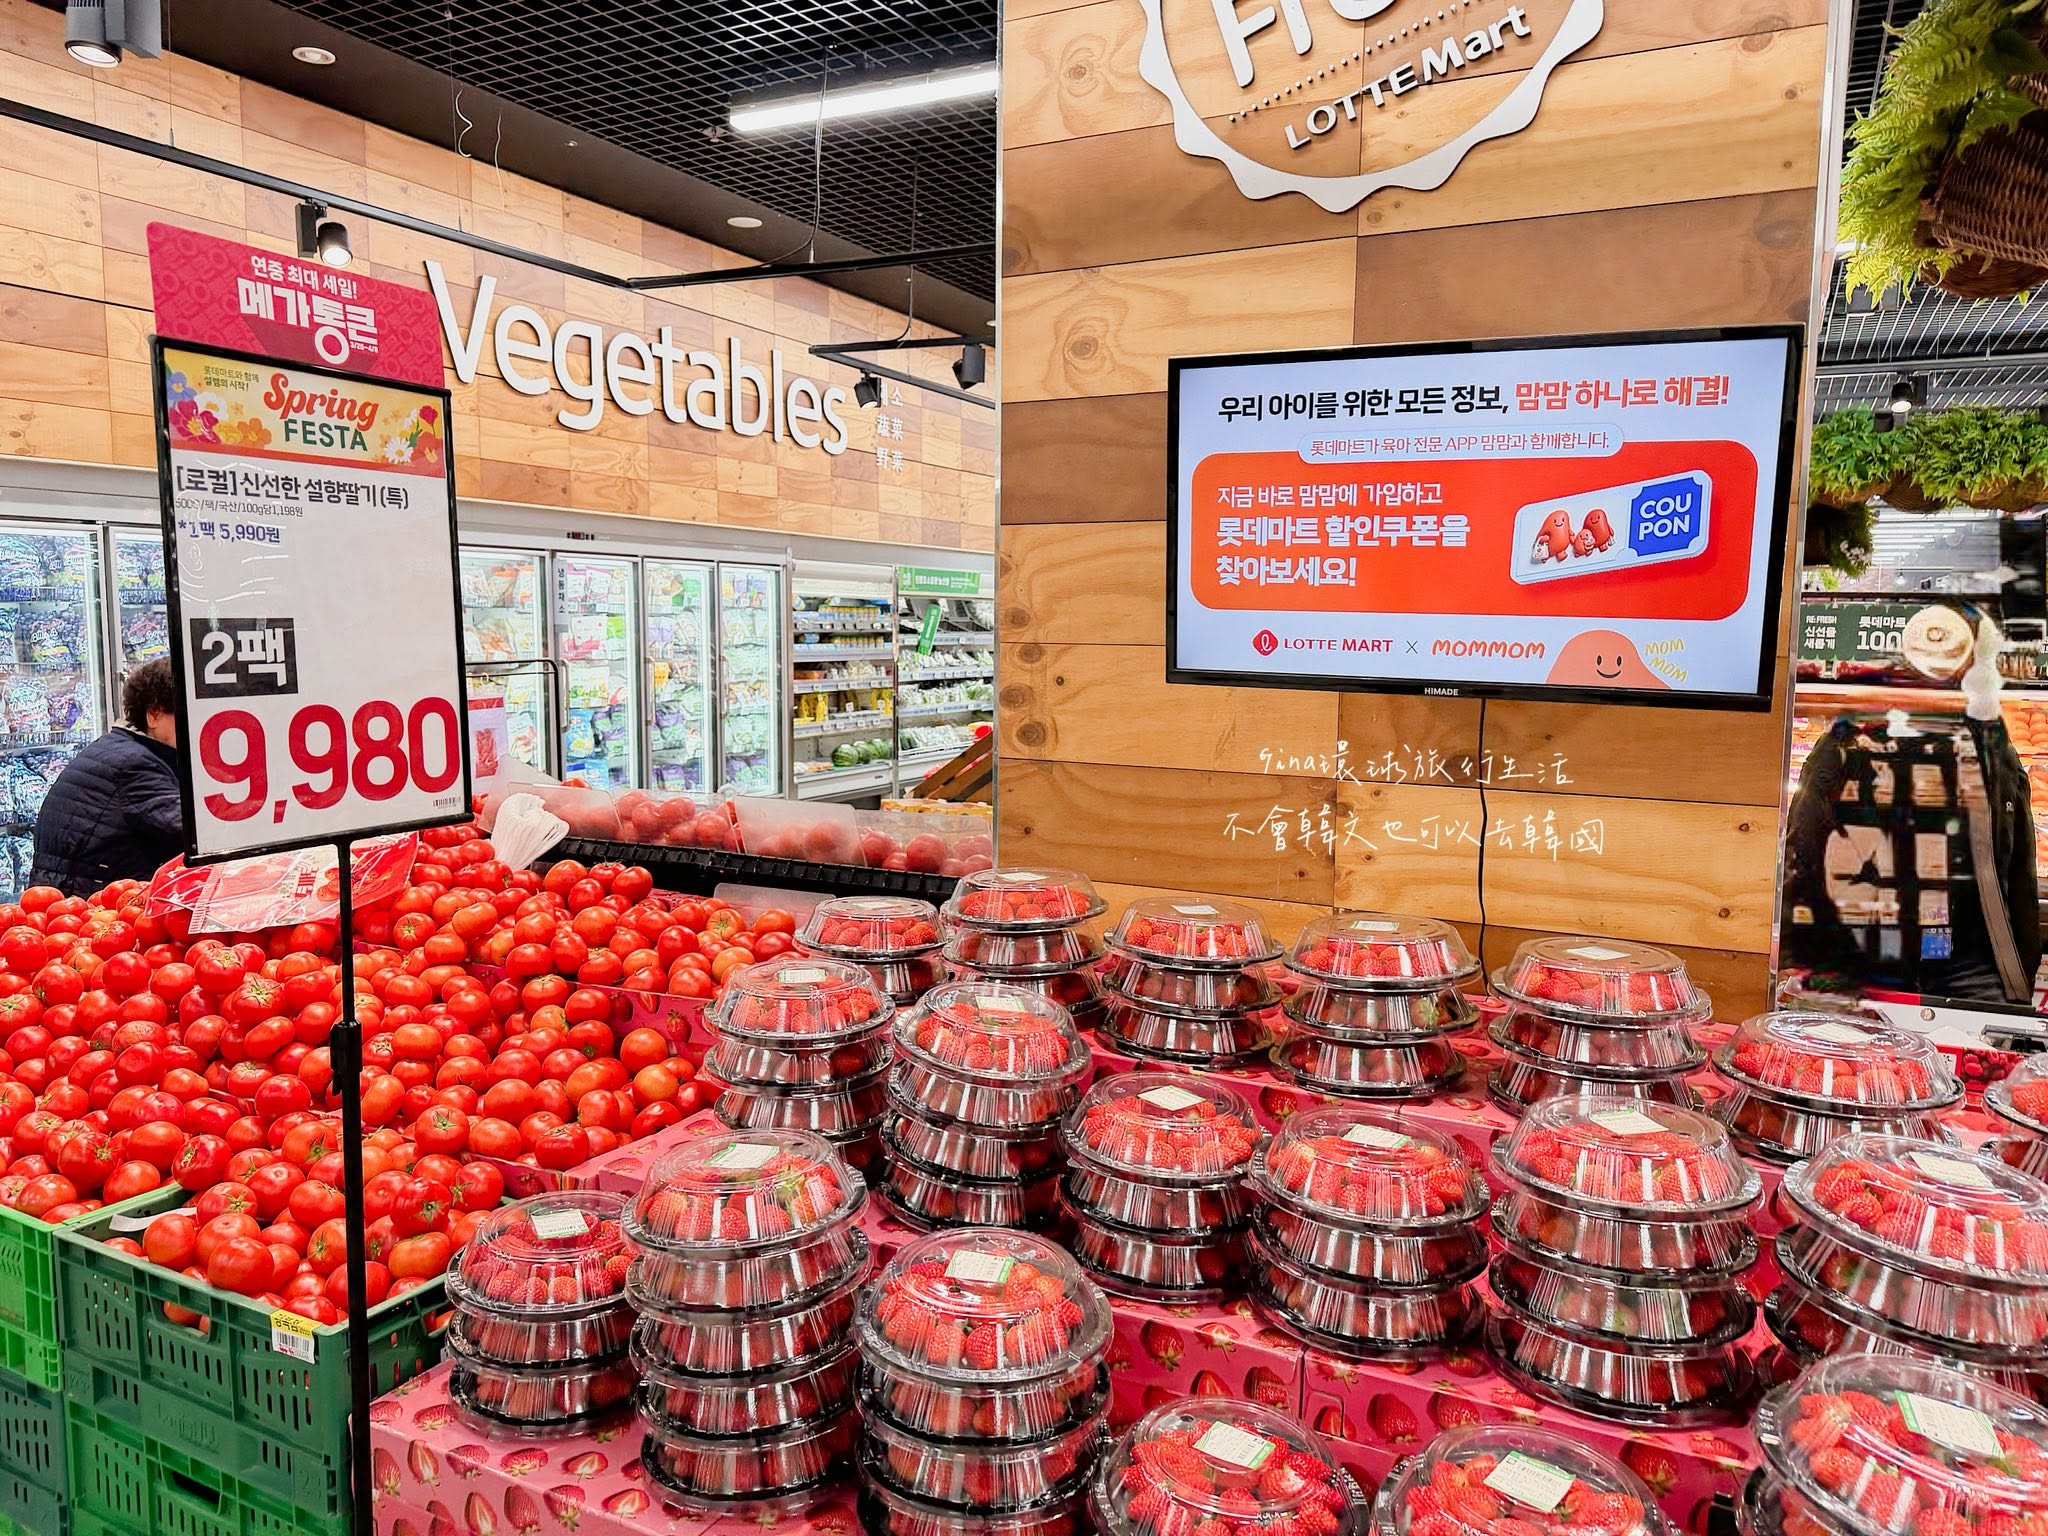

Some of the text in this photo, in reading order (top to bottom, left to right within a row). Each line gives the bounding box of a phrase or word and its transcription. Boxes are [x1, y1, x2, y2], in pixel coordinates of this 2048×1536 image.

[1284, 60, 1419, 150] LOTTE
[1421, 5, 1532, 84] Mart
[250, 255, 358, 300] 연중 최대 세일!
[237, 277, 379, 365] 메가통큰
[423, 260, 849, 455] Vegetables
[204, 366, 243, 380] 롯데마트와
[230, 380, 250, 392] 시작!
[263, 372, 379, 432] Spring
[1218, 375, 1729, 422] 우리 아이를 위한 모든 정보, 맘맘 하나로 해결!
[284, 418, 368, 452] FESTA
[1310, 431, 1610, 456] 롯데마트가 육아 전문 APP 맘맘과 함께합니다.
[1217, 482, 1443, 508] 지금 바로 맘맘에 가입하고
[1639, 493, 1692, 519] COU
[219, 523, 281, 543] 5,990원
[1217, 514, 1471, 547] 롯데마트 할인쿠폰을
[1638, 514, 1690, 541] PON
[1216, 556, 1357, 586] 찾아보세요!
[1859, 616, 1907, 629] 롯데마트
[200, 628, 288, 688] 2팩
[1284, 637, 1337, 651] LOTTE
[1342, 637, 1394, 653] MART
[1644, 637, 1685, 656] MOM
[1649, 656, 1688, 683] MOM
[1424, 686, 1459, 696] HIMADE
[198, 696, 461, 825] 9,980
